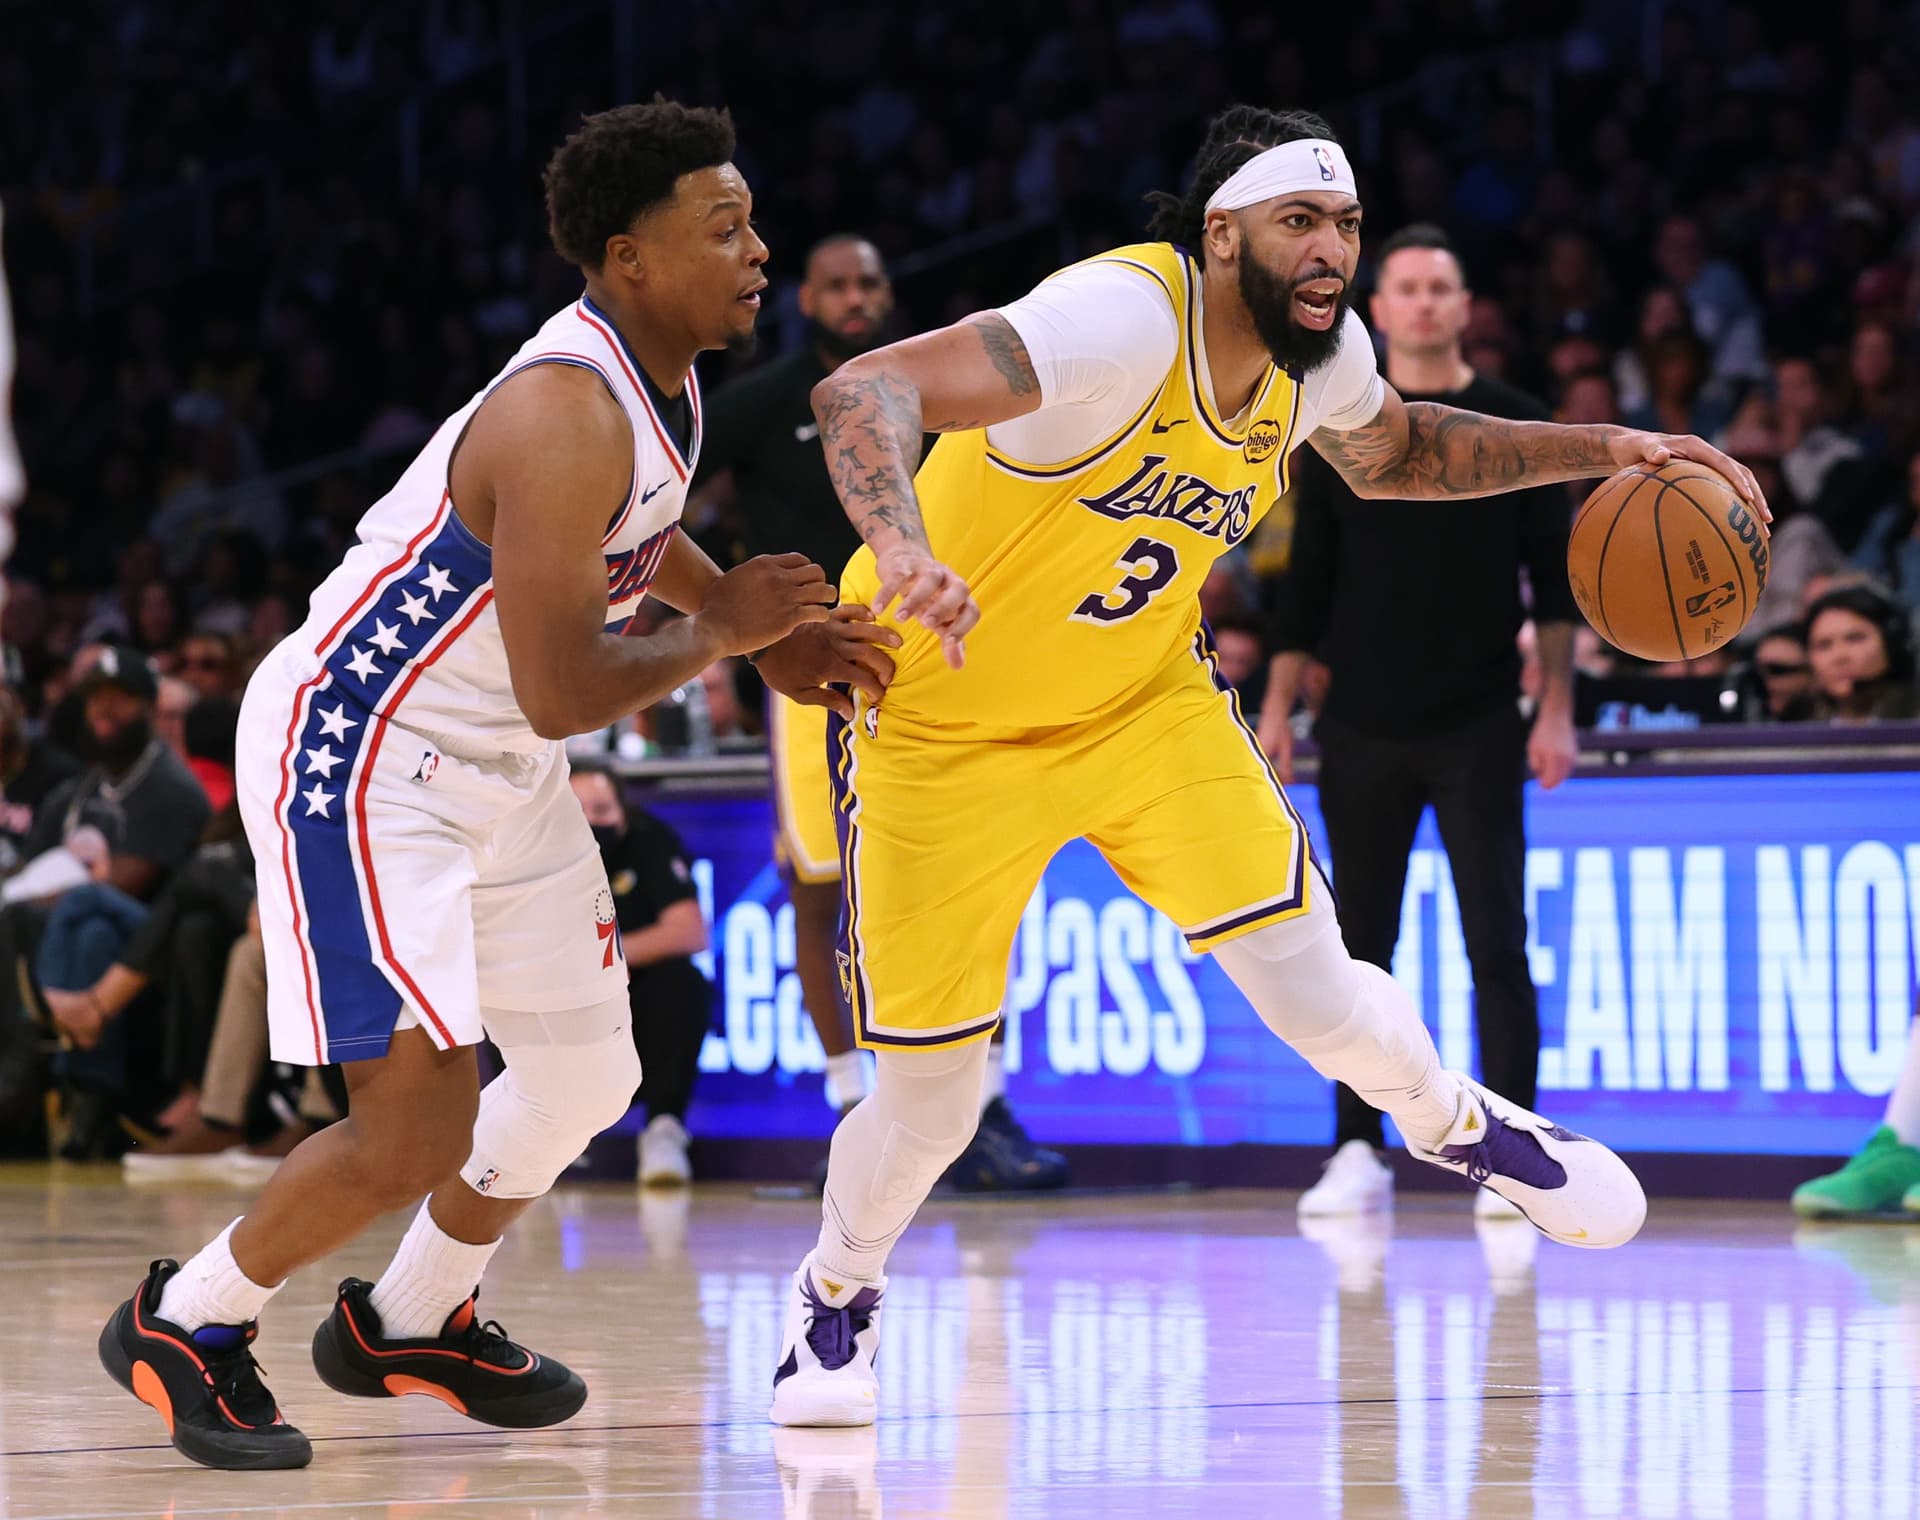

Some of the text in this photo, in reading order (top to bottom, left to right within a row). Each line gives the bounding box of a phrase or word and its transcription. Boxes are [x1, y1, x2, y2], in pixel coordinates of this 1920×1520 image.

[1247, 431, 1278, 450] bibigo
[1075, 454, 1257, 546] LAKERS
[1069, 536, 1180, 626] 3
[595, 915, 623, 970] 7
[1002, 878, 1206, 1076] Pass
[1756, 840, 1920, 1097] NO
